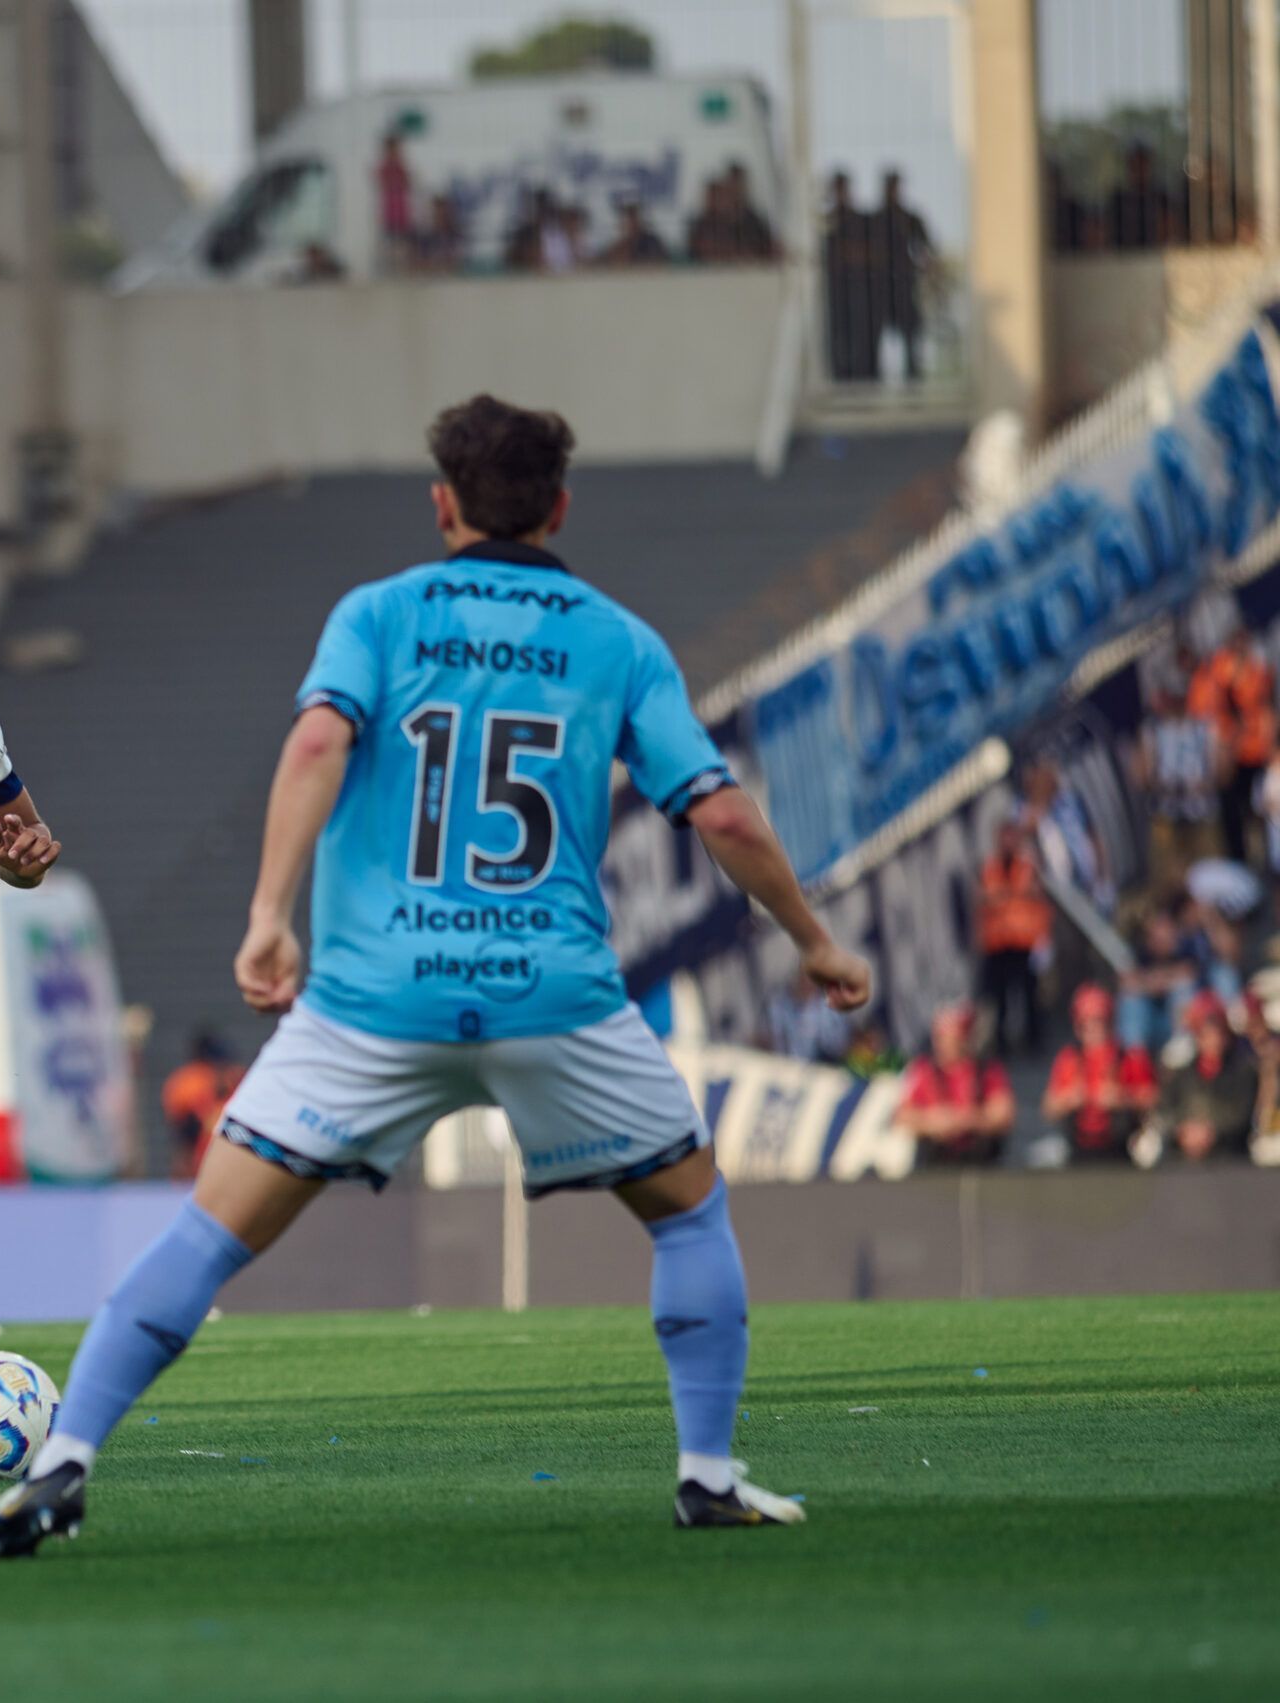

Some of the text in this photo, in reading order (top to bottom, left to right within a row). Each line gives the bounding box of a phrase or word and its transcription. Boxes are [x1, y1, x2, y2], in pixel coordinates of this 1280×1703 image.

[415, 639, 569, 679] MENOSSI
[400, 701, 566, 895] 15
[385, 903, 552, 932] Alcance
[414, 952, 531, 984] playcet
